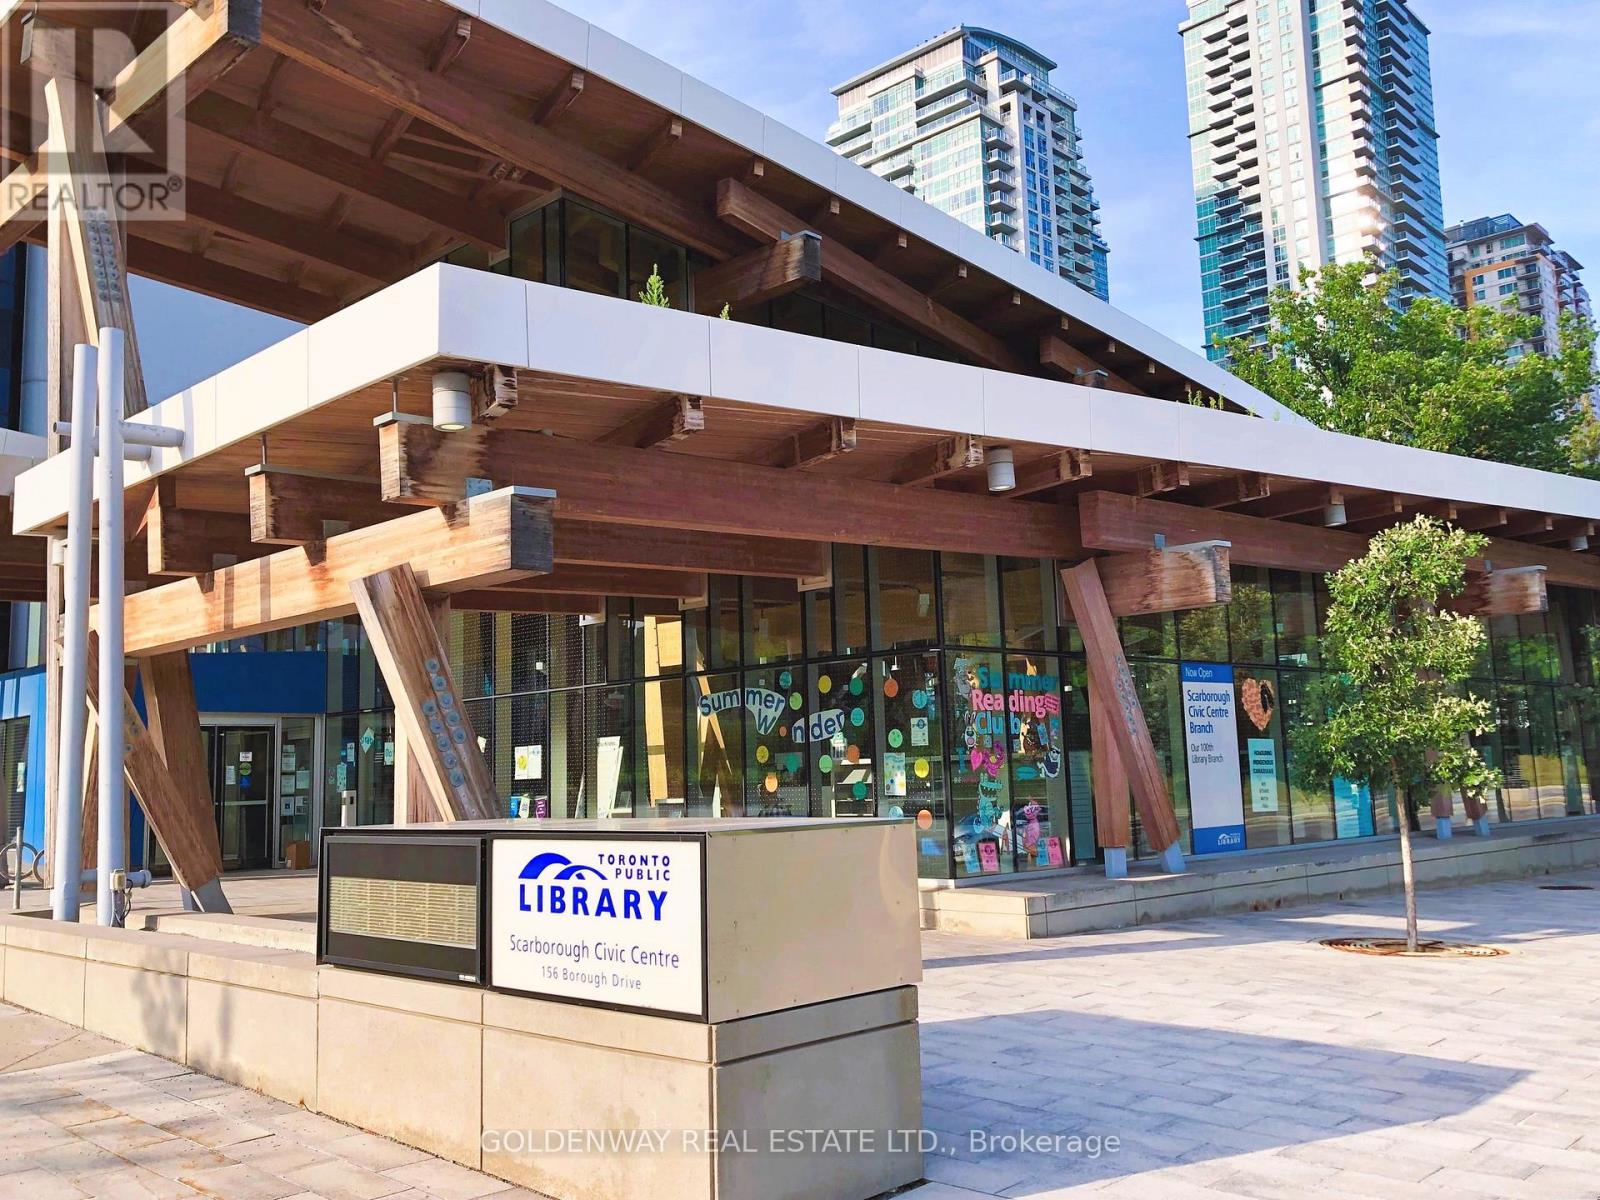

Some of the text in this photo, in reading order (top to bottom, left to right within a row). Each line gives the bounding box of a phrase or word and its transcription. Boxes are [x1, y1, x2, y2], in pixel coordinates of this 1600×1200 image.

[1185, 667, 1213, 680] Now Open
[700, 688, 784, 717] Summer
[971, 689, 1047, 719] Reading
[1187, 689, 1231, 705] Scarborough
[1188, 705, 1229, 718] Civic Centre
[975, 711, 1020, 735] Club
[1189, 721, 1214, 734] Branch
[598, 853, 671, 867] TORONTO
[615, 868, 671, 881] PUBLIC
[519, 883, 668, 921] LIBRARY
[510, 934, 680, 969] Scarborough Civic Centre
[542, 965, 642, 990] 156 Borough Drive
